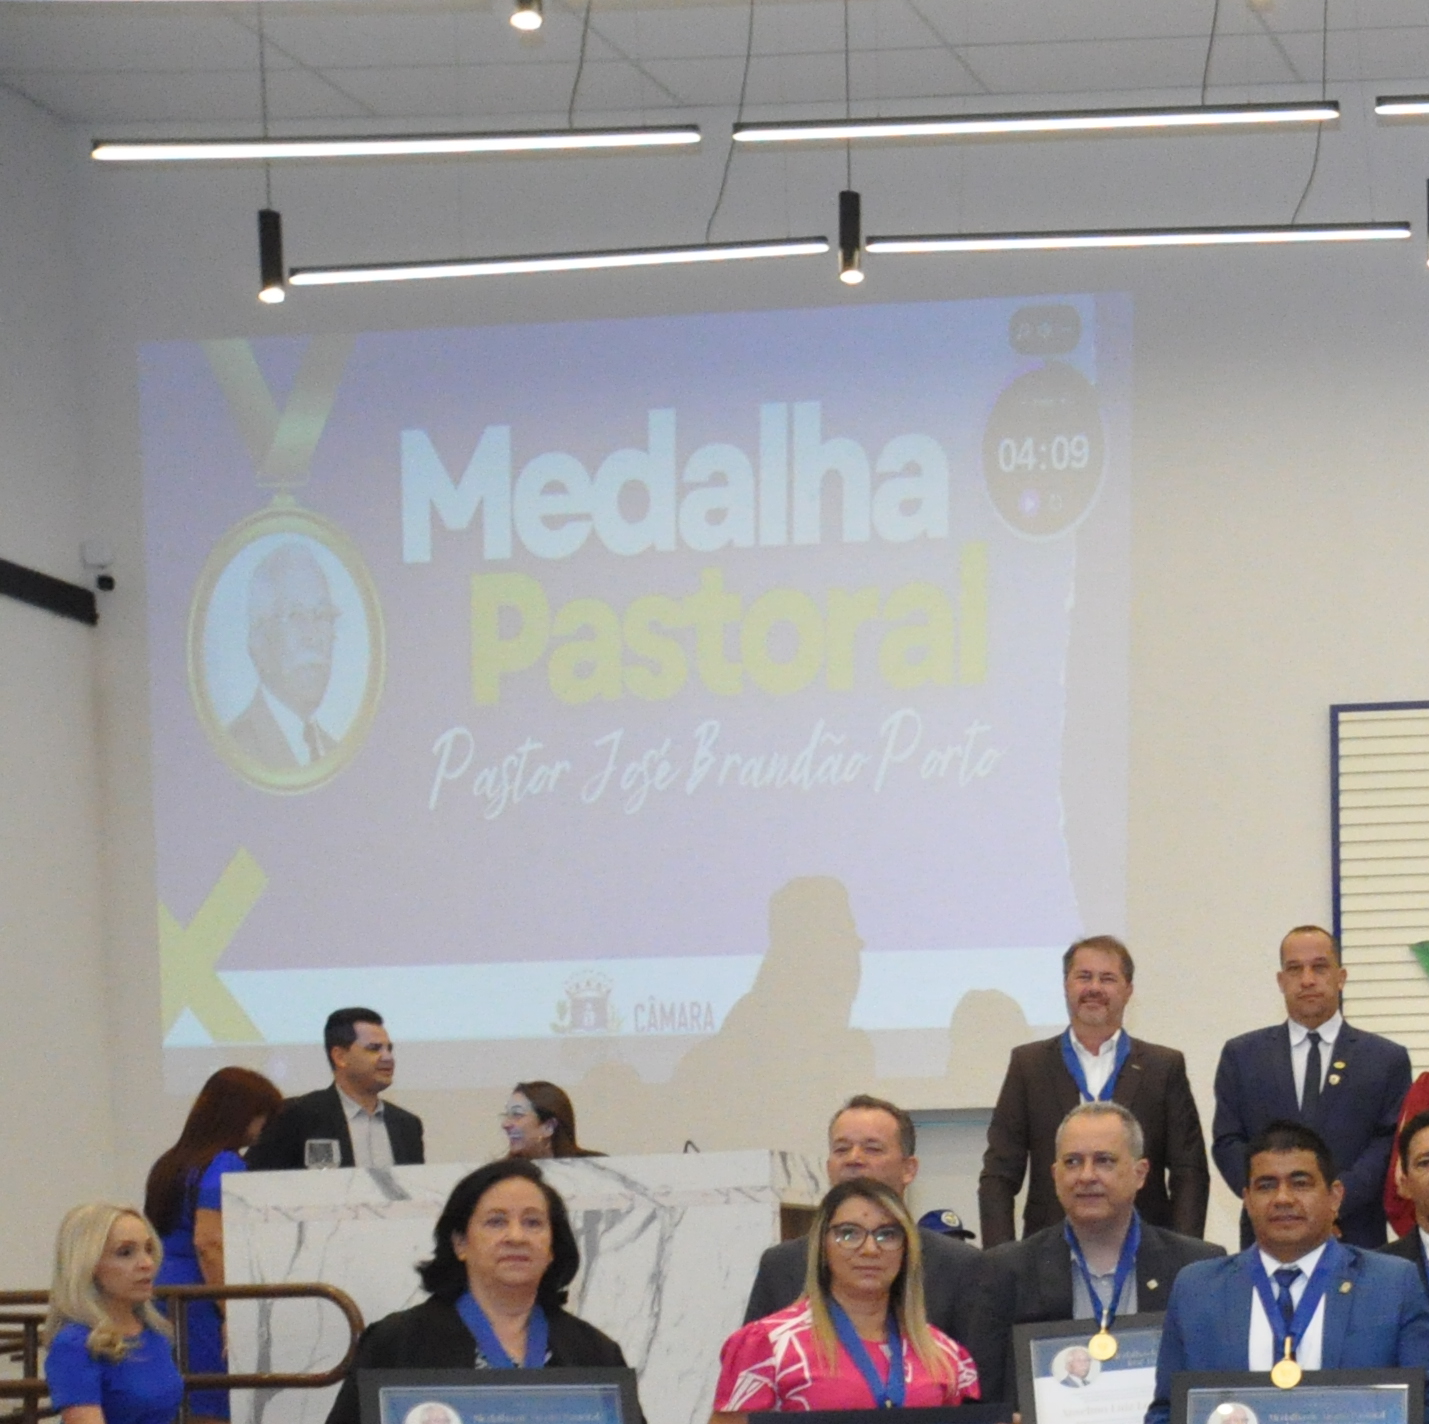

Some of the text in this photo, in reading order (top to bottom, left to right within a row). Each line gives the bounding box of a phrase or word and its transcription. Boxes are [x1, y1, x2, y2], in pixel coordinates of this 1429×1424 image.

[400, 402, 949, 564] Medalha
[999, 434, 1090, 472] 04:09
[470, 541, 989, 705] Pastoral
[428, 707, 1005, 818] Pastor José Brandão Porto
[633, 994, 715, 1033] CÂMARA
